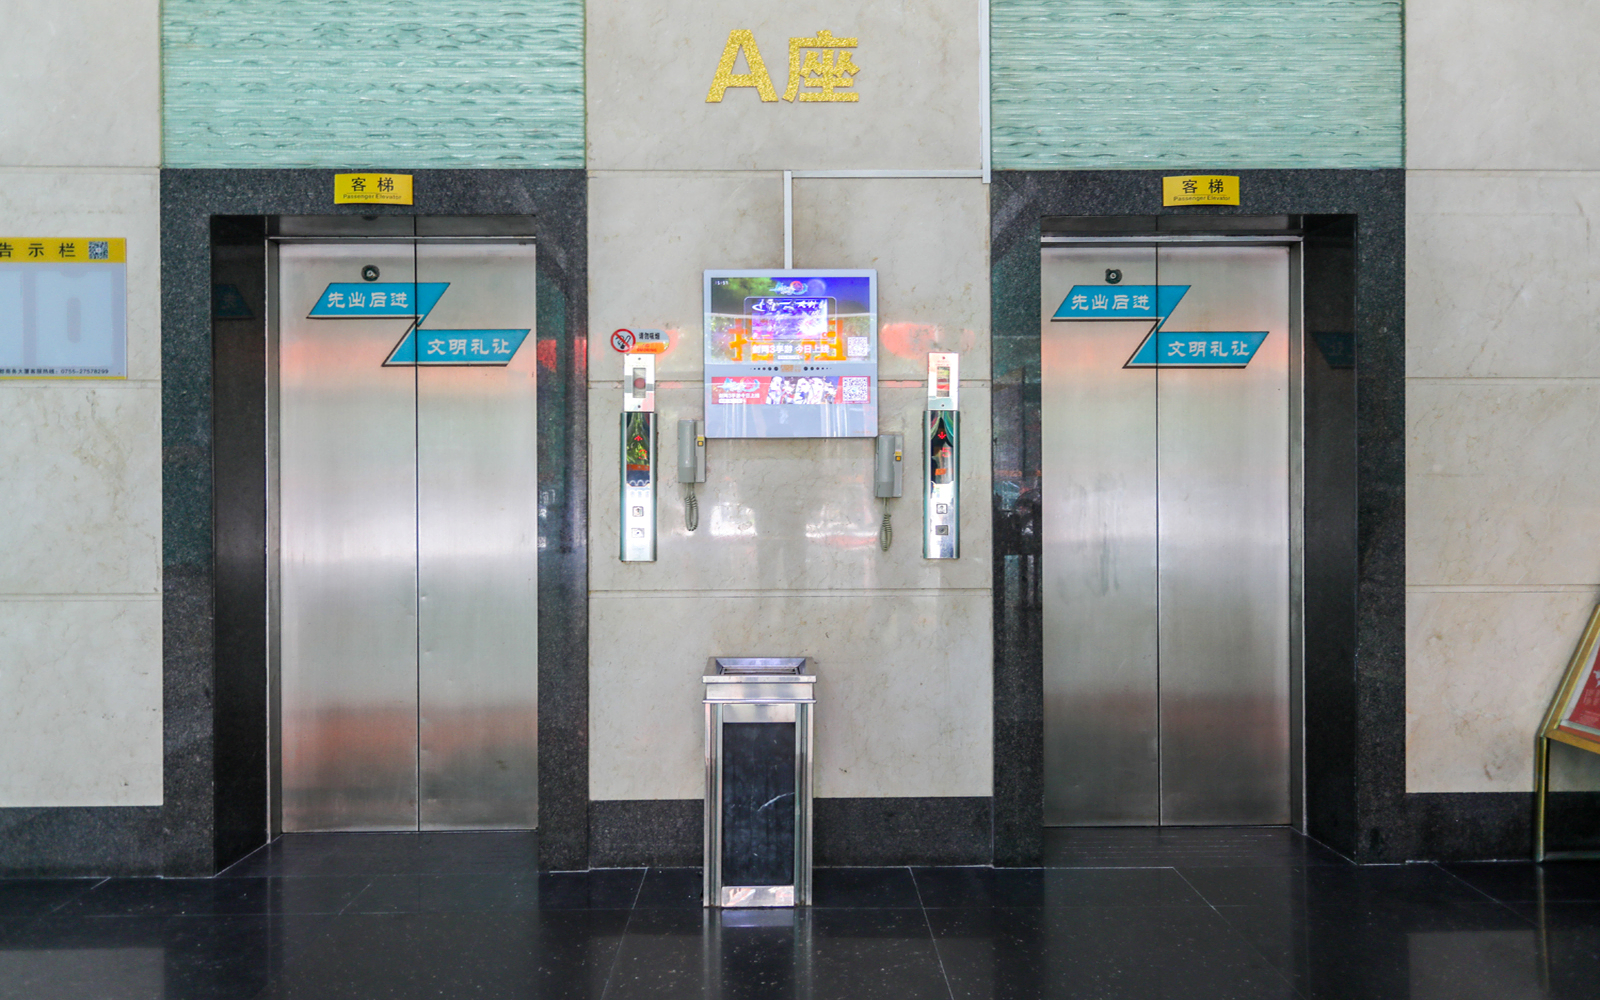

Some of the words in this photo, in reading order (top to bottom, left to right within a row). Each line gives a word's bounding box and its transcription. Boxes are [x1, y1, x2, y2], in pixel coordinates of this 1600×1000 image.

[705, 29, 860, 103] A座
[351, 177, 394, 192] 客梯
[1182, 179, 1224, 194] 客梯
[0, 242, 76, 258] 告示栏
[327, 291, 409, 309] 先出后进
[1070, 294, 1150, 311] 先出后进
[427, 338, 511, 356] 文明礼让
[1167, 340, 1250, 358] 文明礼让
[941, 447, 951, 458] 5
